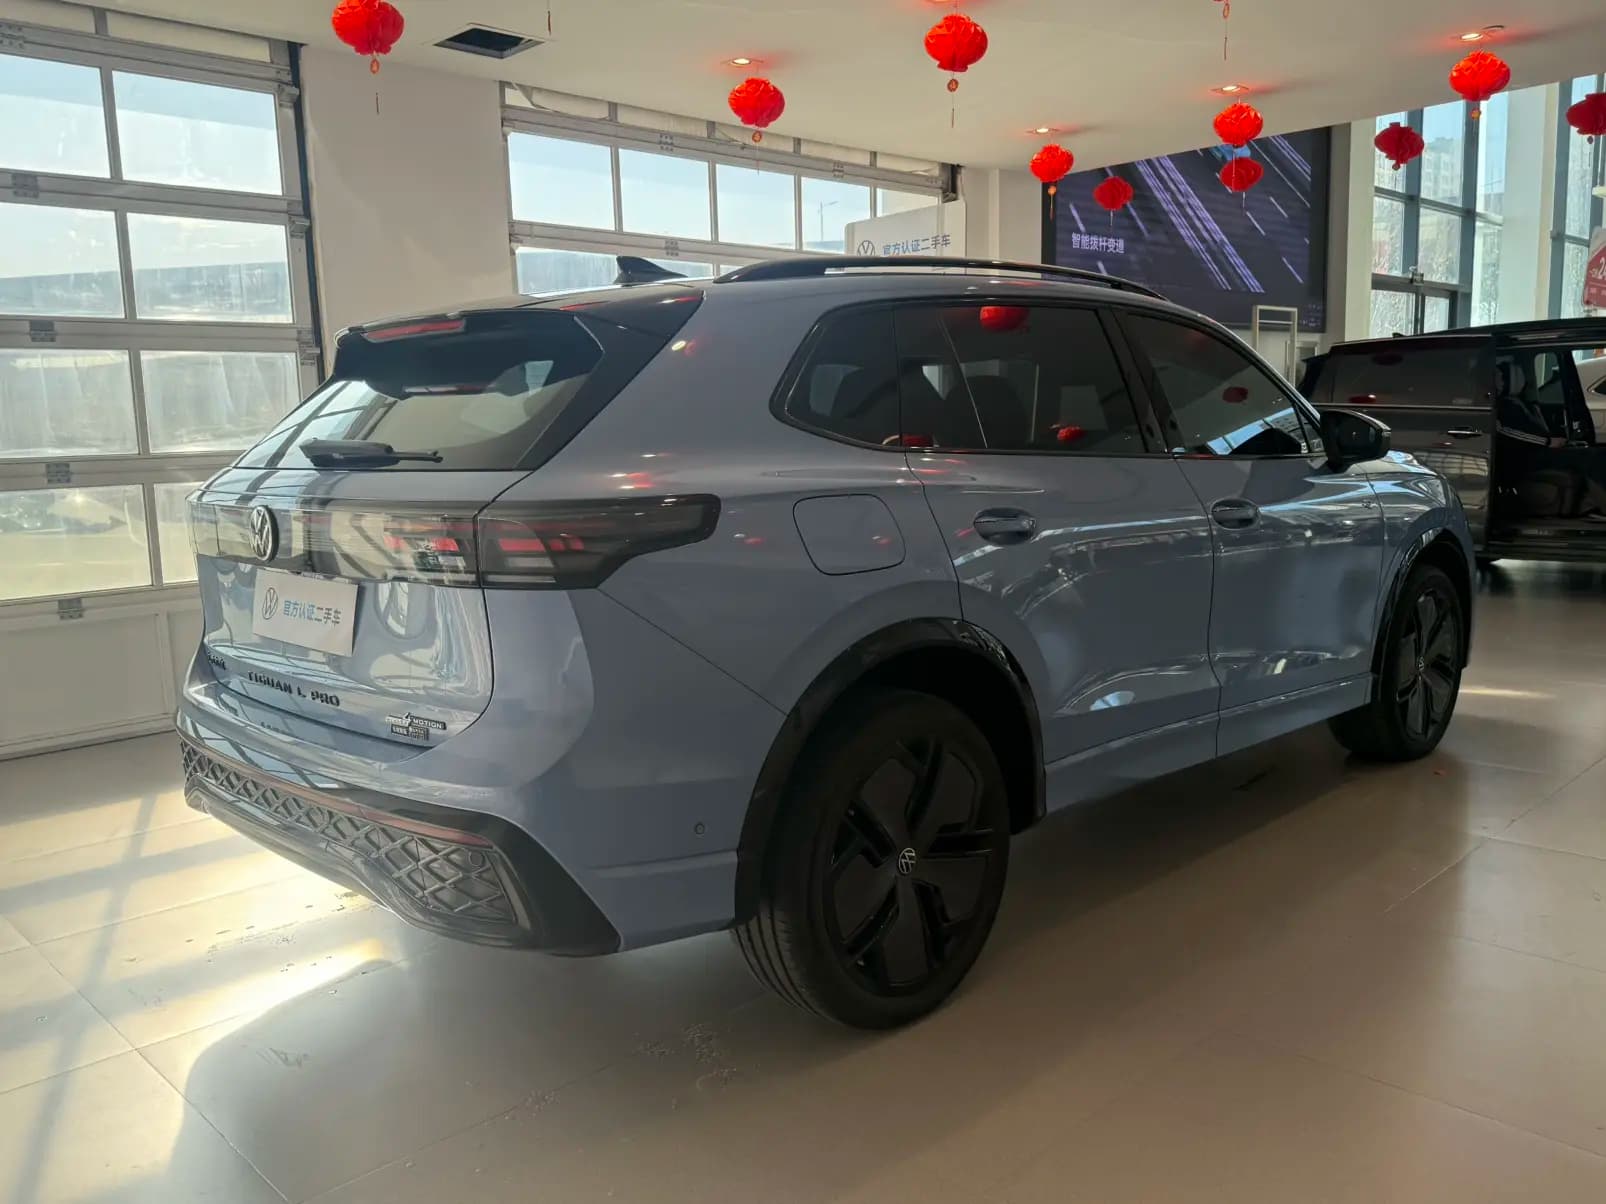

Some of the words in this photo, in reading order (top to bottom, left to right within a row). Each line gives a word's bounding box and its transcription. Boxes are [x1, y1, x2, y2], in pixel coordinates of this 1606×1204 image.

[883, 234, 951, 256] 官方认证二手车
[283, 600, 342, 627] 官方认证二手车
[248, 672, 293, 695] TIGUAN
[297, 686, 307, 698] L
[310, 690, 341, 707] PRO
